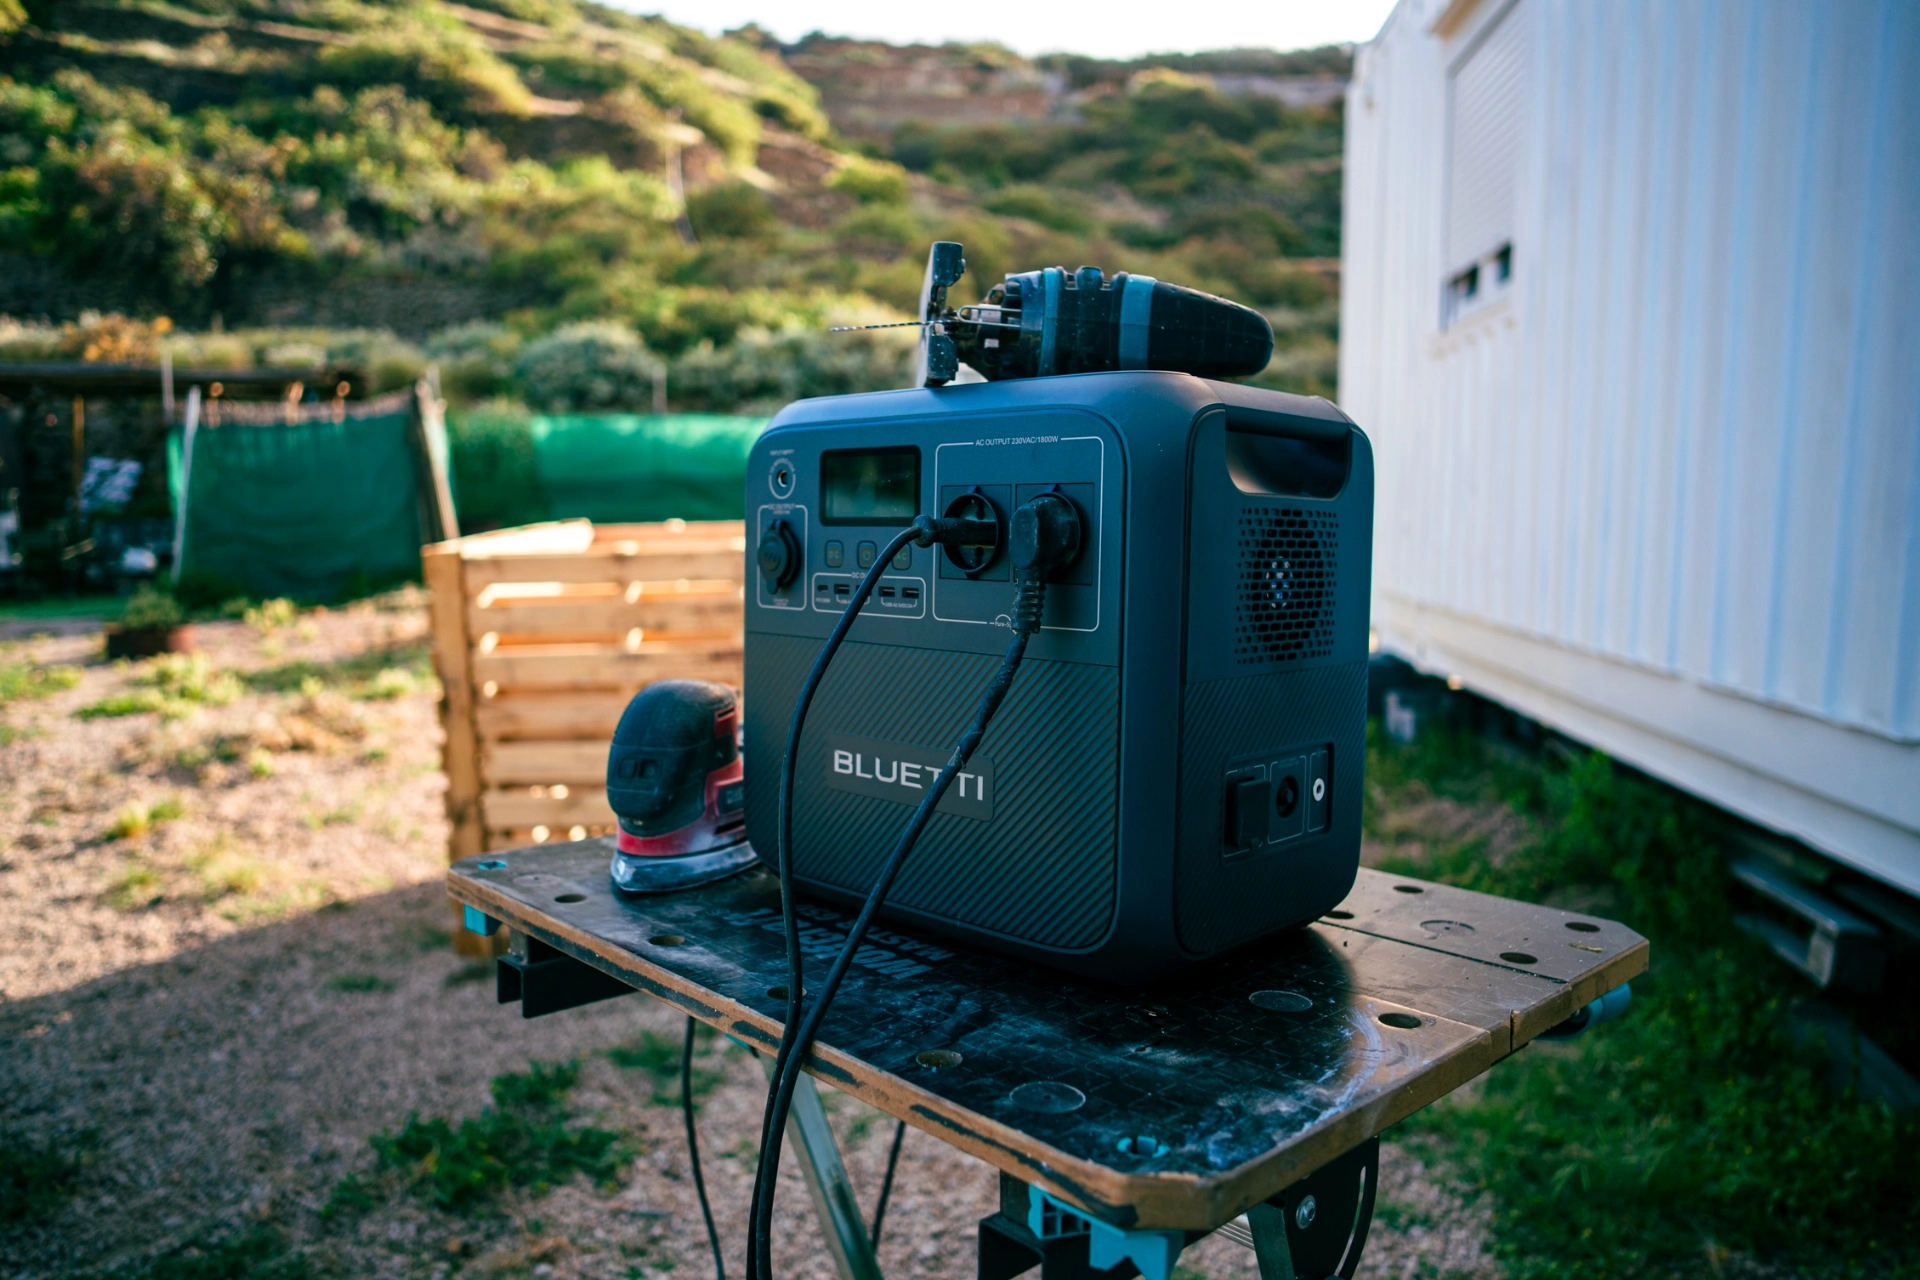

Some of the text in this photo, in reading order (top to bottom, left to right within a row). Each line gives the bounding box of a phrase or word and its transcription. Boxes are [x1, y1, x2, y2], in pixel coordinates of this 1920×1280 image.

[985, 437, 1011, 446] OUTPUT
[1011, 435, 1059, 445] 230VAC/1800W
[829, 550, 839, 559] DC
[834, 749, 984, 801] BLUETTI
